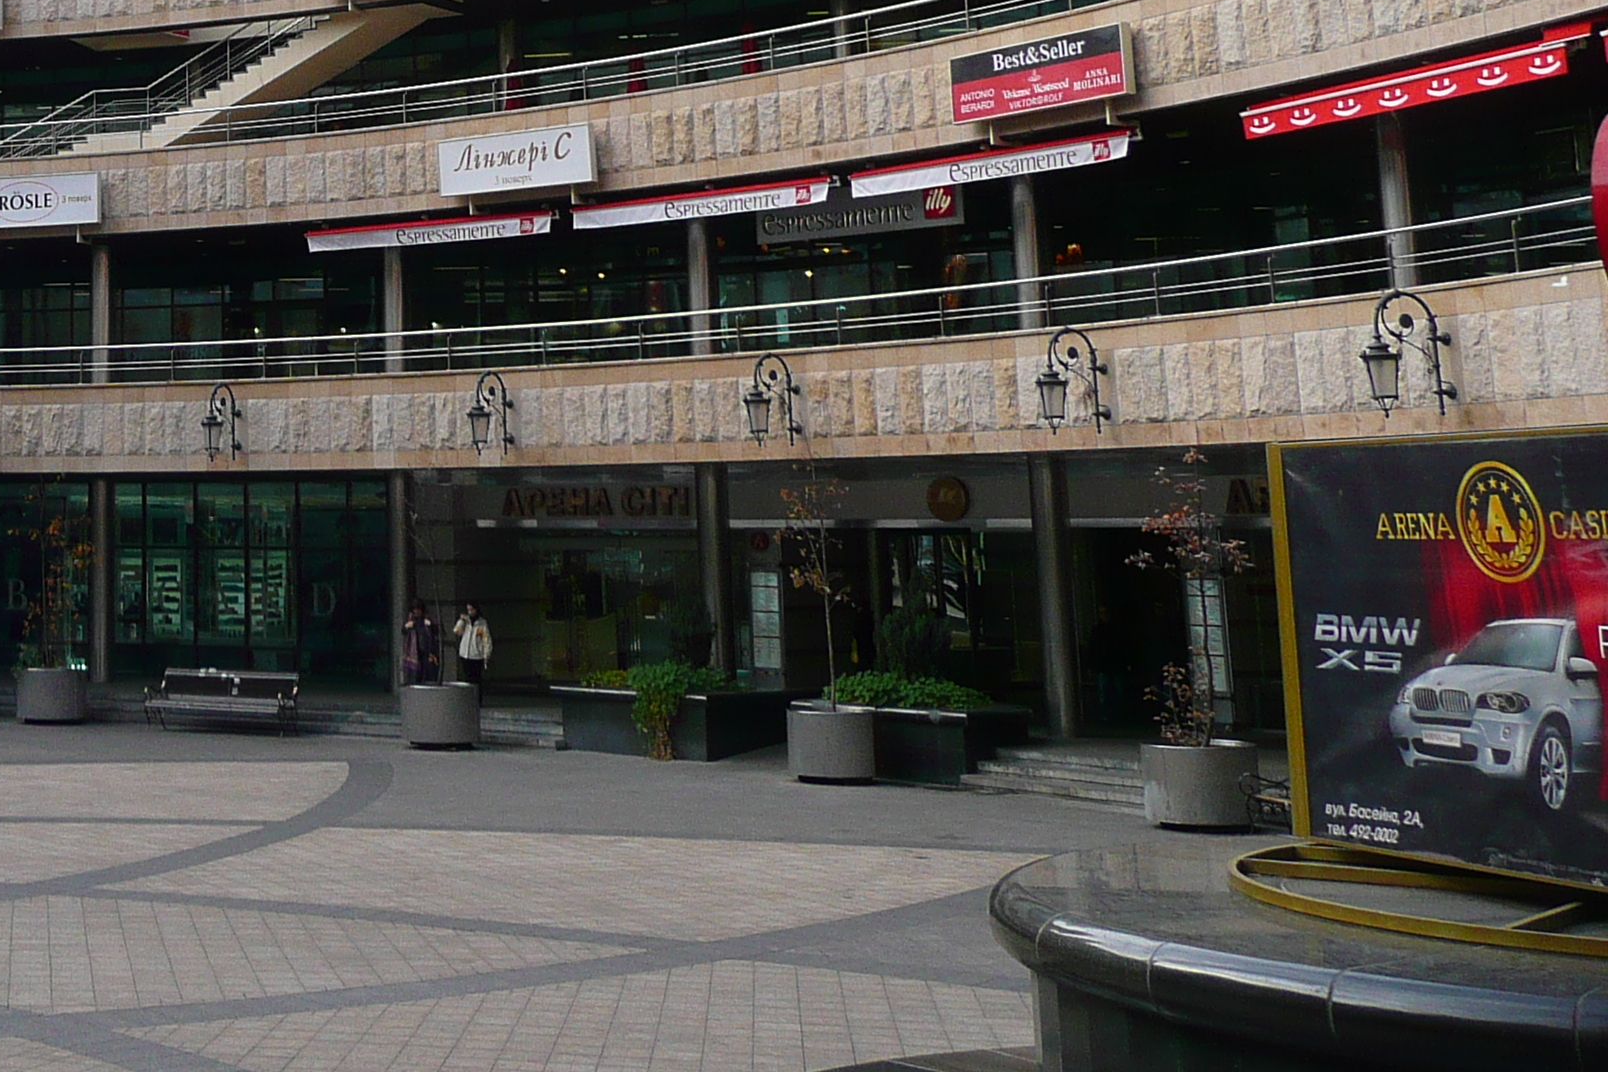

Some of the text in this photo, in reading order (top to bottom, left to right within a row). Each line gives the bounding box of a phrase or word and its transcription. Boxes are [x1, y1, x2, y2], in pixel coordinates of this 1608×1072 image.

[992, 39, 1085, 72] Best&Seller
[1073, 73, 1121, 91] MOLINARI
[1085, 66, 1108, 78] ANNA
[959, 88, 995, 102] ANTONIO
[960, 100, 995, 114] BERARDI
[453, 141, 549, 172] Лінжері
[949, 149, 1078, 182] espressamente
[0, 191, 53, 211] RÖSLE
[664, 192, 781, 219] espressamente
[763, 187, 952, 235] espressamente illy
[396, 222, 507, 244] espressamente
[1376, 513, 1457, 540] ARENA
[1314, 613, 1421, 646] BMW
[1315, 648, 1403, 674] X5
[1349, 823, 1399, 844] 492-0002
